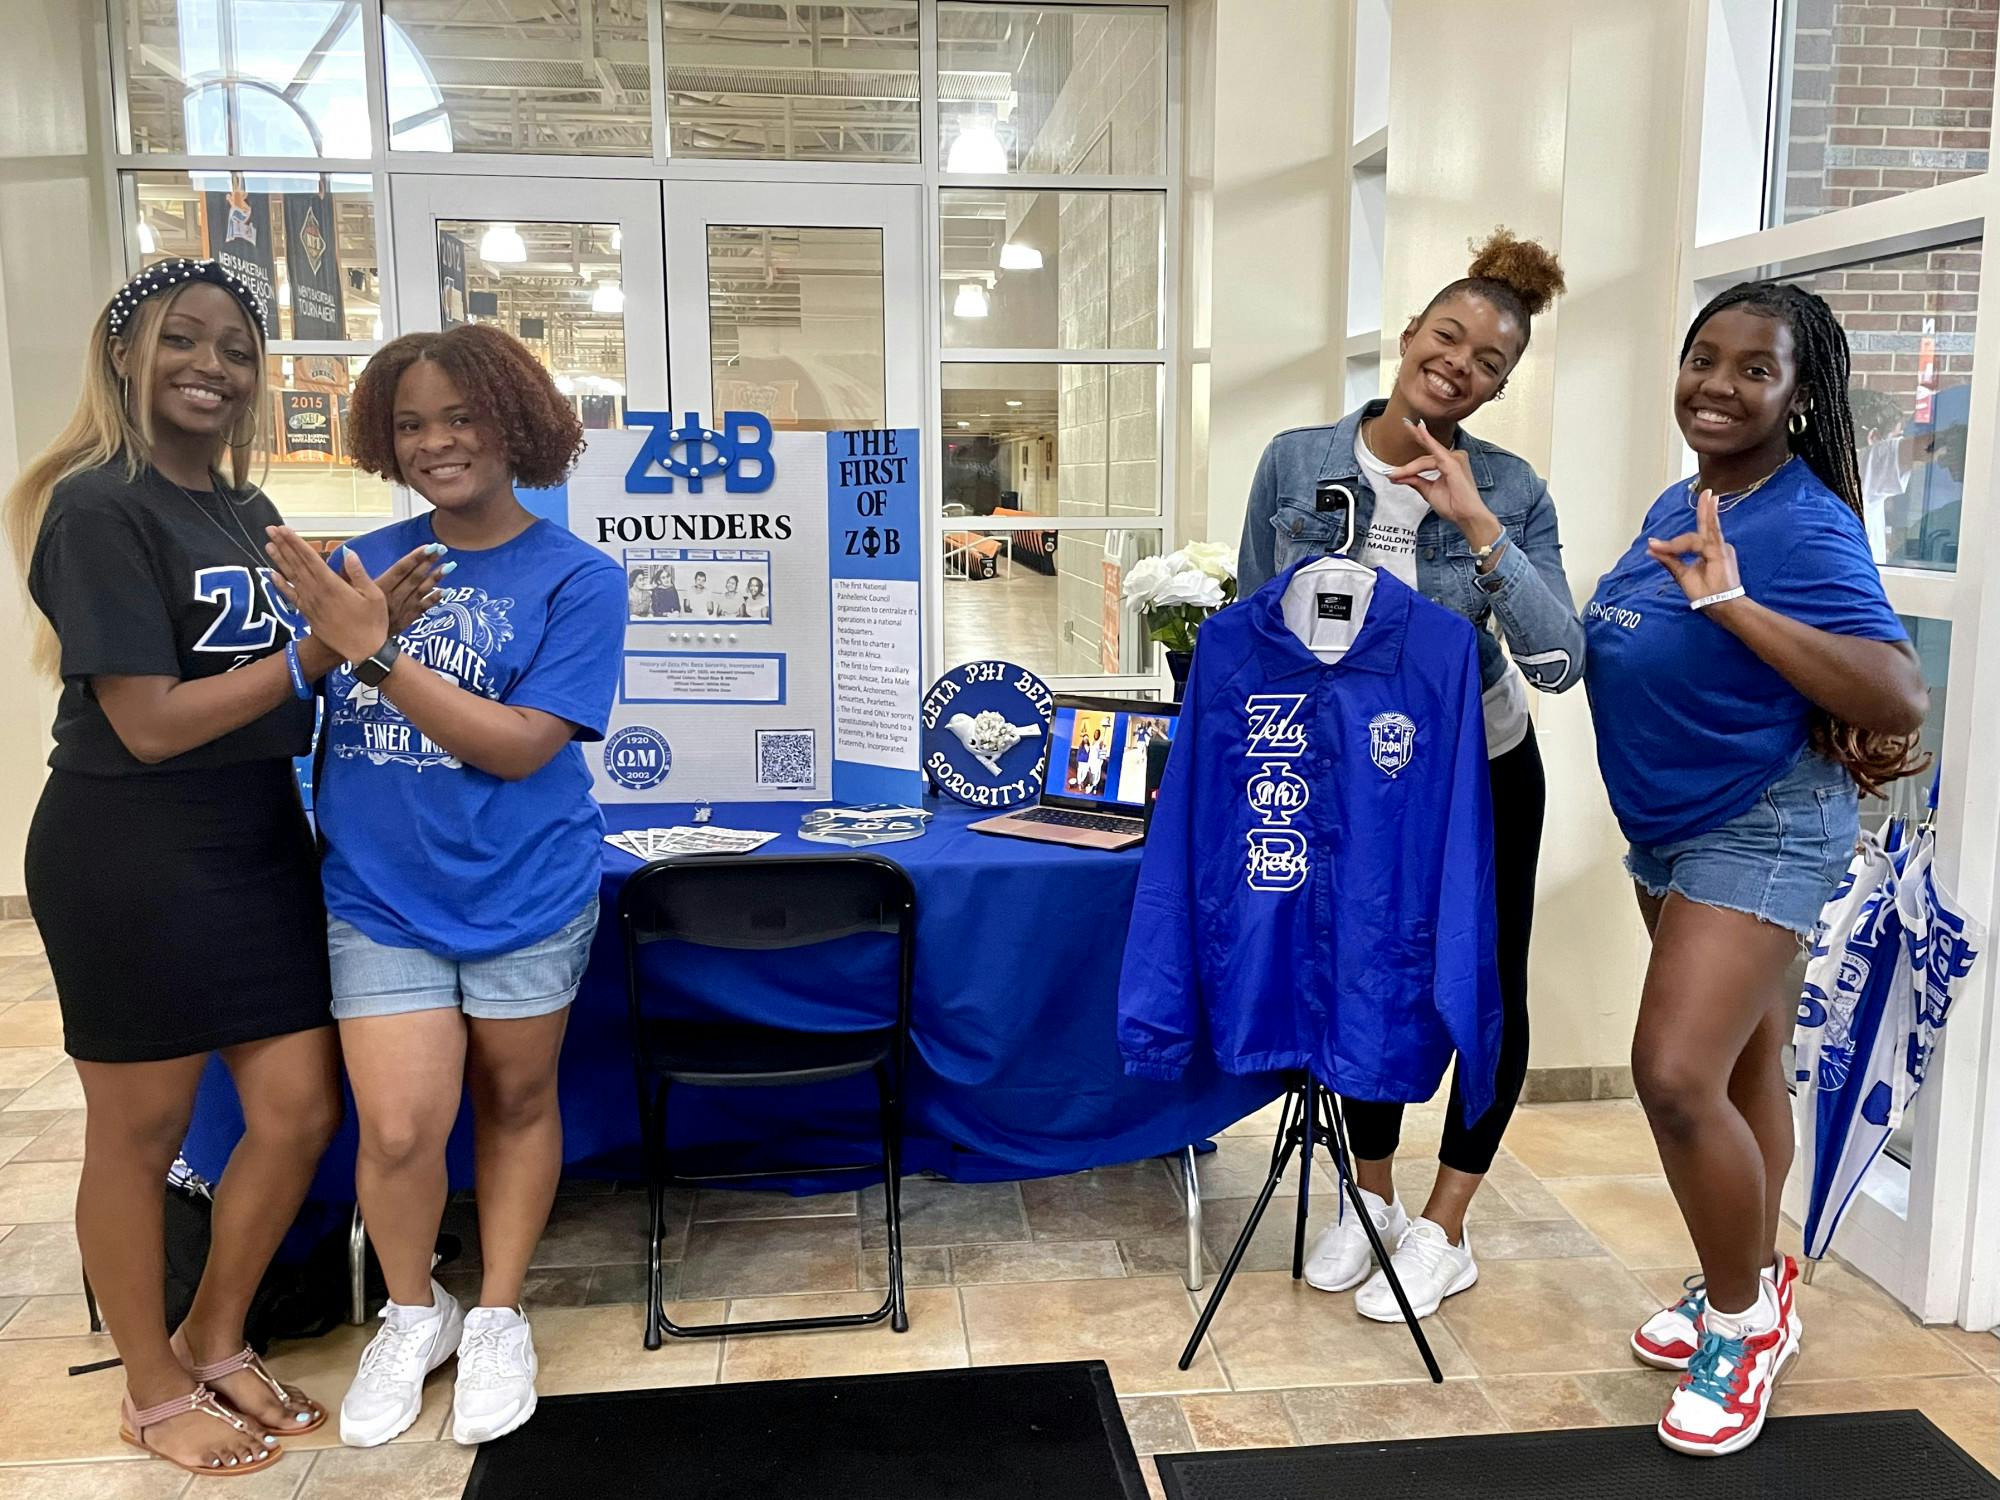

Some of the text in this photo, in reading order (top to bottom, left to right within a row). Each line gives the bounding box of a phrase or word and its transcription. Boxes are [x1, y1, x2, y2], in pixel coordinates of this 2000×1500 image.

[299, 298, 336, 323] TOURNAMENT
[291, 396, 323, 409] 2015
[844, 429, 898, 456] THE
[839, 457, 908, 487] FIRST
[857, 490, 887, 517] OF
[596, 513, 792, 543] FOUNDERS
[1368, 542, 1398, 553] MADE
[840, 581, 887, 591] The first National
[837, 605, 870, 613] organization
[879, 607, 907, 615] centralize
[1588, 601, 1642, 629] SINCE 1920
[837, 616, 865, 625] operations
[878, 618, 902, 626] national
[840, 637, 850, 645] The
[851, 638, 861, 646] first
[869, 640, 890, 649] charter
[837, 649, 857, 658] chapter
[840, 661, 850, 669] The
[851, 662, 861, 670] first
[870, 663, 883, 671] form
[884, 666, 909, 675] auxiliary
[881, 676, 893, 684] Zeta
[895, 677, 909, 685] Male
[922, 680, 961, 730] ZETA
[965, 663, 1006, 684] PHI
[841, 705, 851, 713] The
[852, 706, 861, 714] first
[874, 710, 890, 718] ONLY
[891, 712, 914, 721] sorority
[880, 721, 899, 730] bound
[900, 723, 907, 731] to
[364, 722, 411, 752] FINER
[866, 730, 874, 738] Phi
[876, 731, 888, 740] Beta
[889, 733, 907, 742] Sigma
